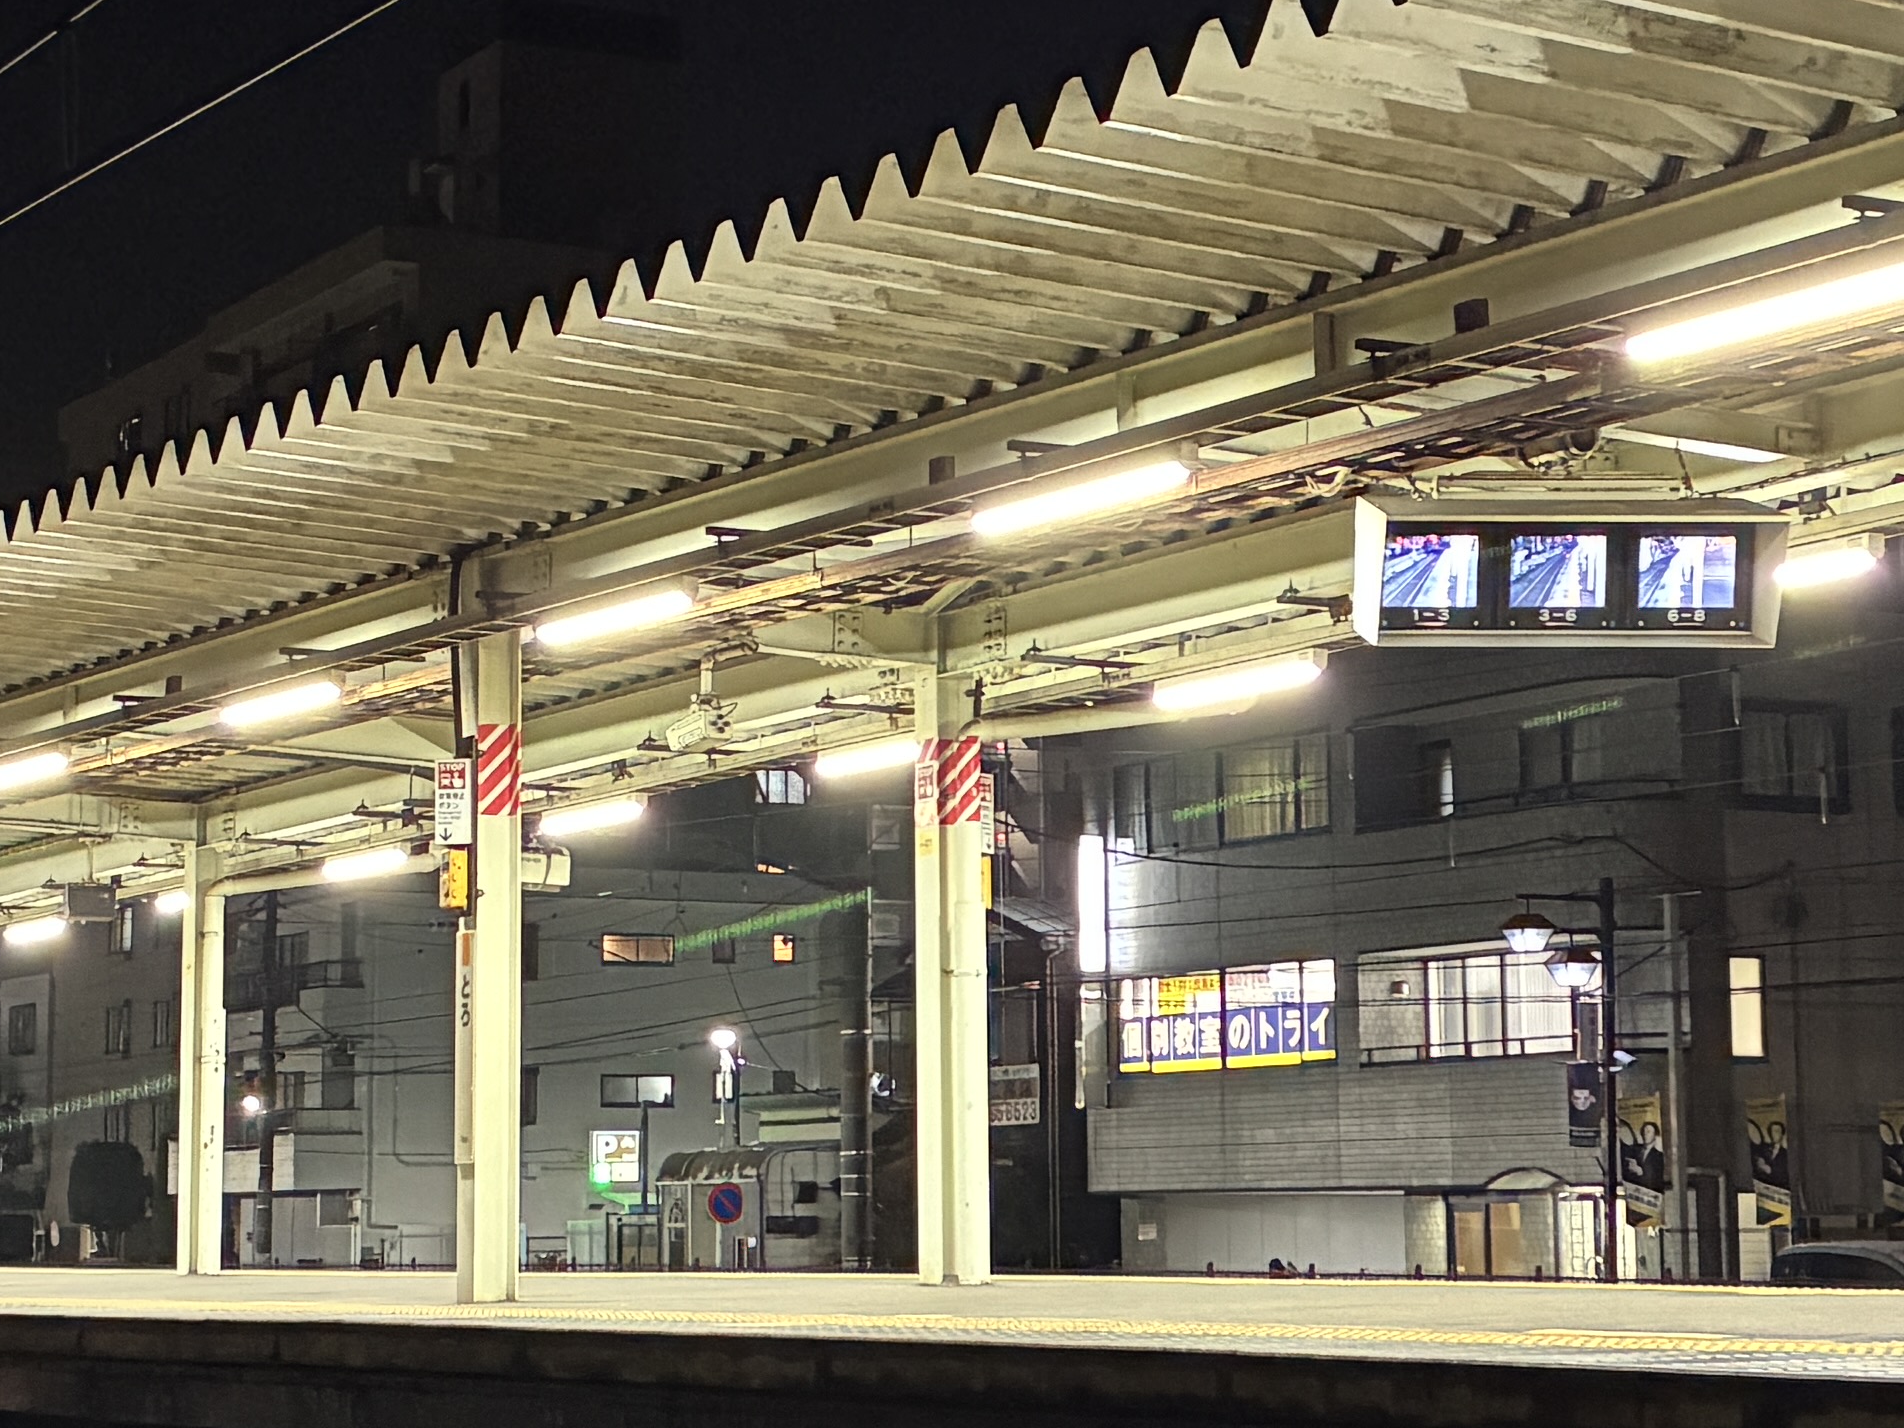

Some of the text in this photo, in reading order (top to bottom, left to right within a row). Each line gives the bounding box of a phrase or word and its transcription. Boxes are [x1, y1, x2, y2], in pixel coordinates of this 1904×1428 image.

[1538, 609, 1578, 622] 3-6
[1666, 610, 1706, 623] 6-8
[439, 763, 465, 772] STOP
